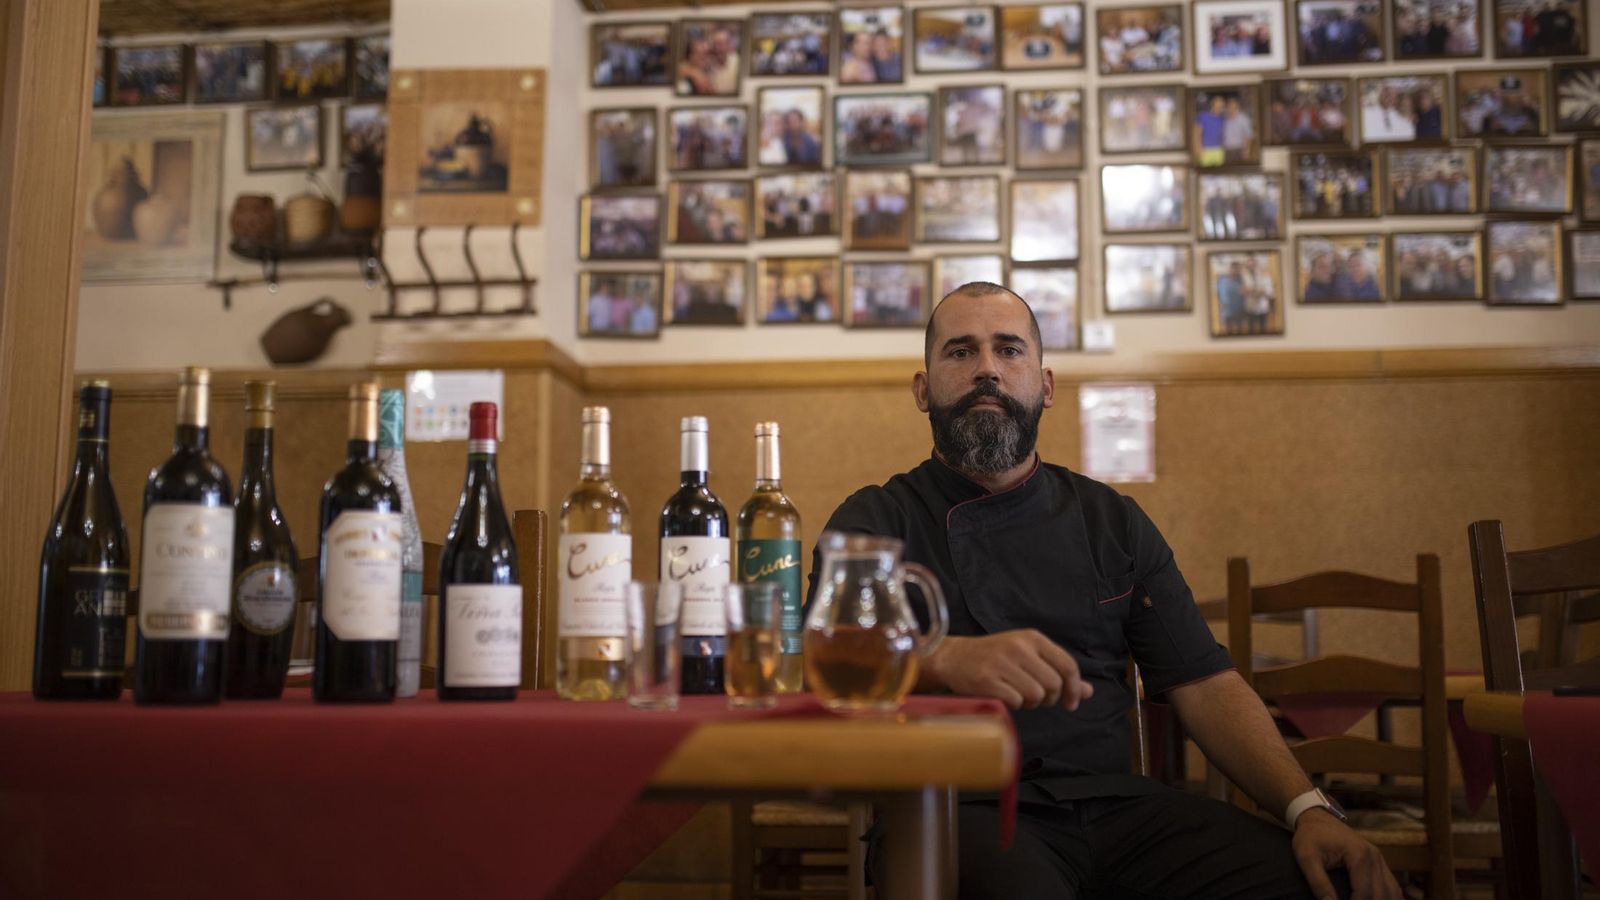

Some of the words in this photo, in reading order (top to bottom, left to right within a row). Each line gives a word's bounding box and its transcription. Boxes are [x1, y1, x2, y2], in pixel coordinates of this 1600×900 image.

[567, 543, 630, 579] Cune
[669, 545, 729, 581] Cune
[743, 546, 800, 582] Cune
